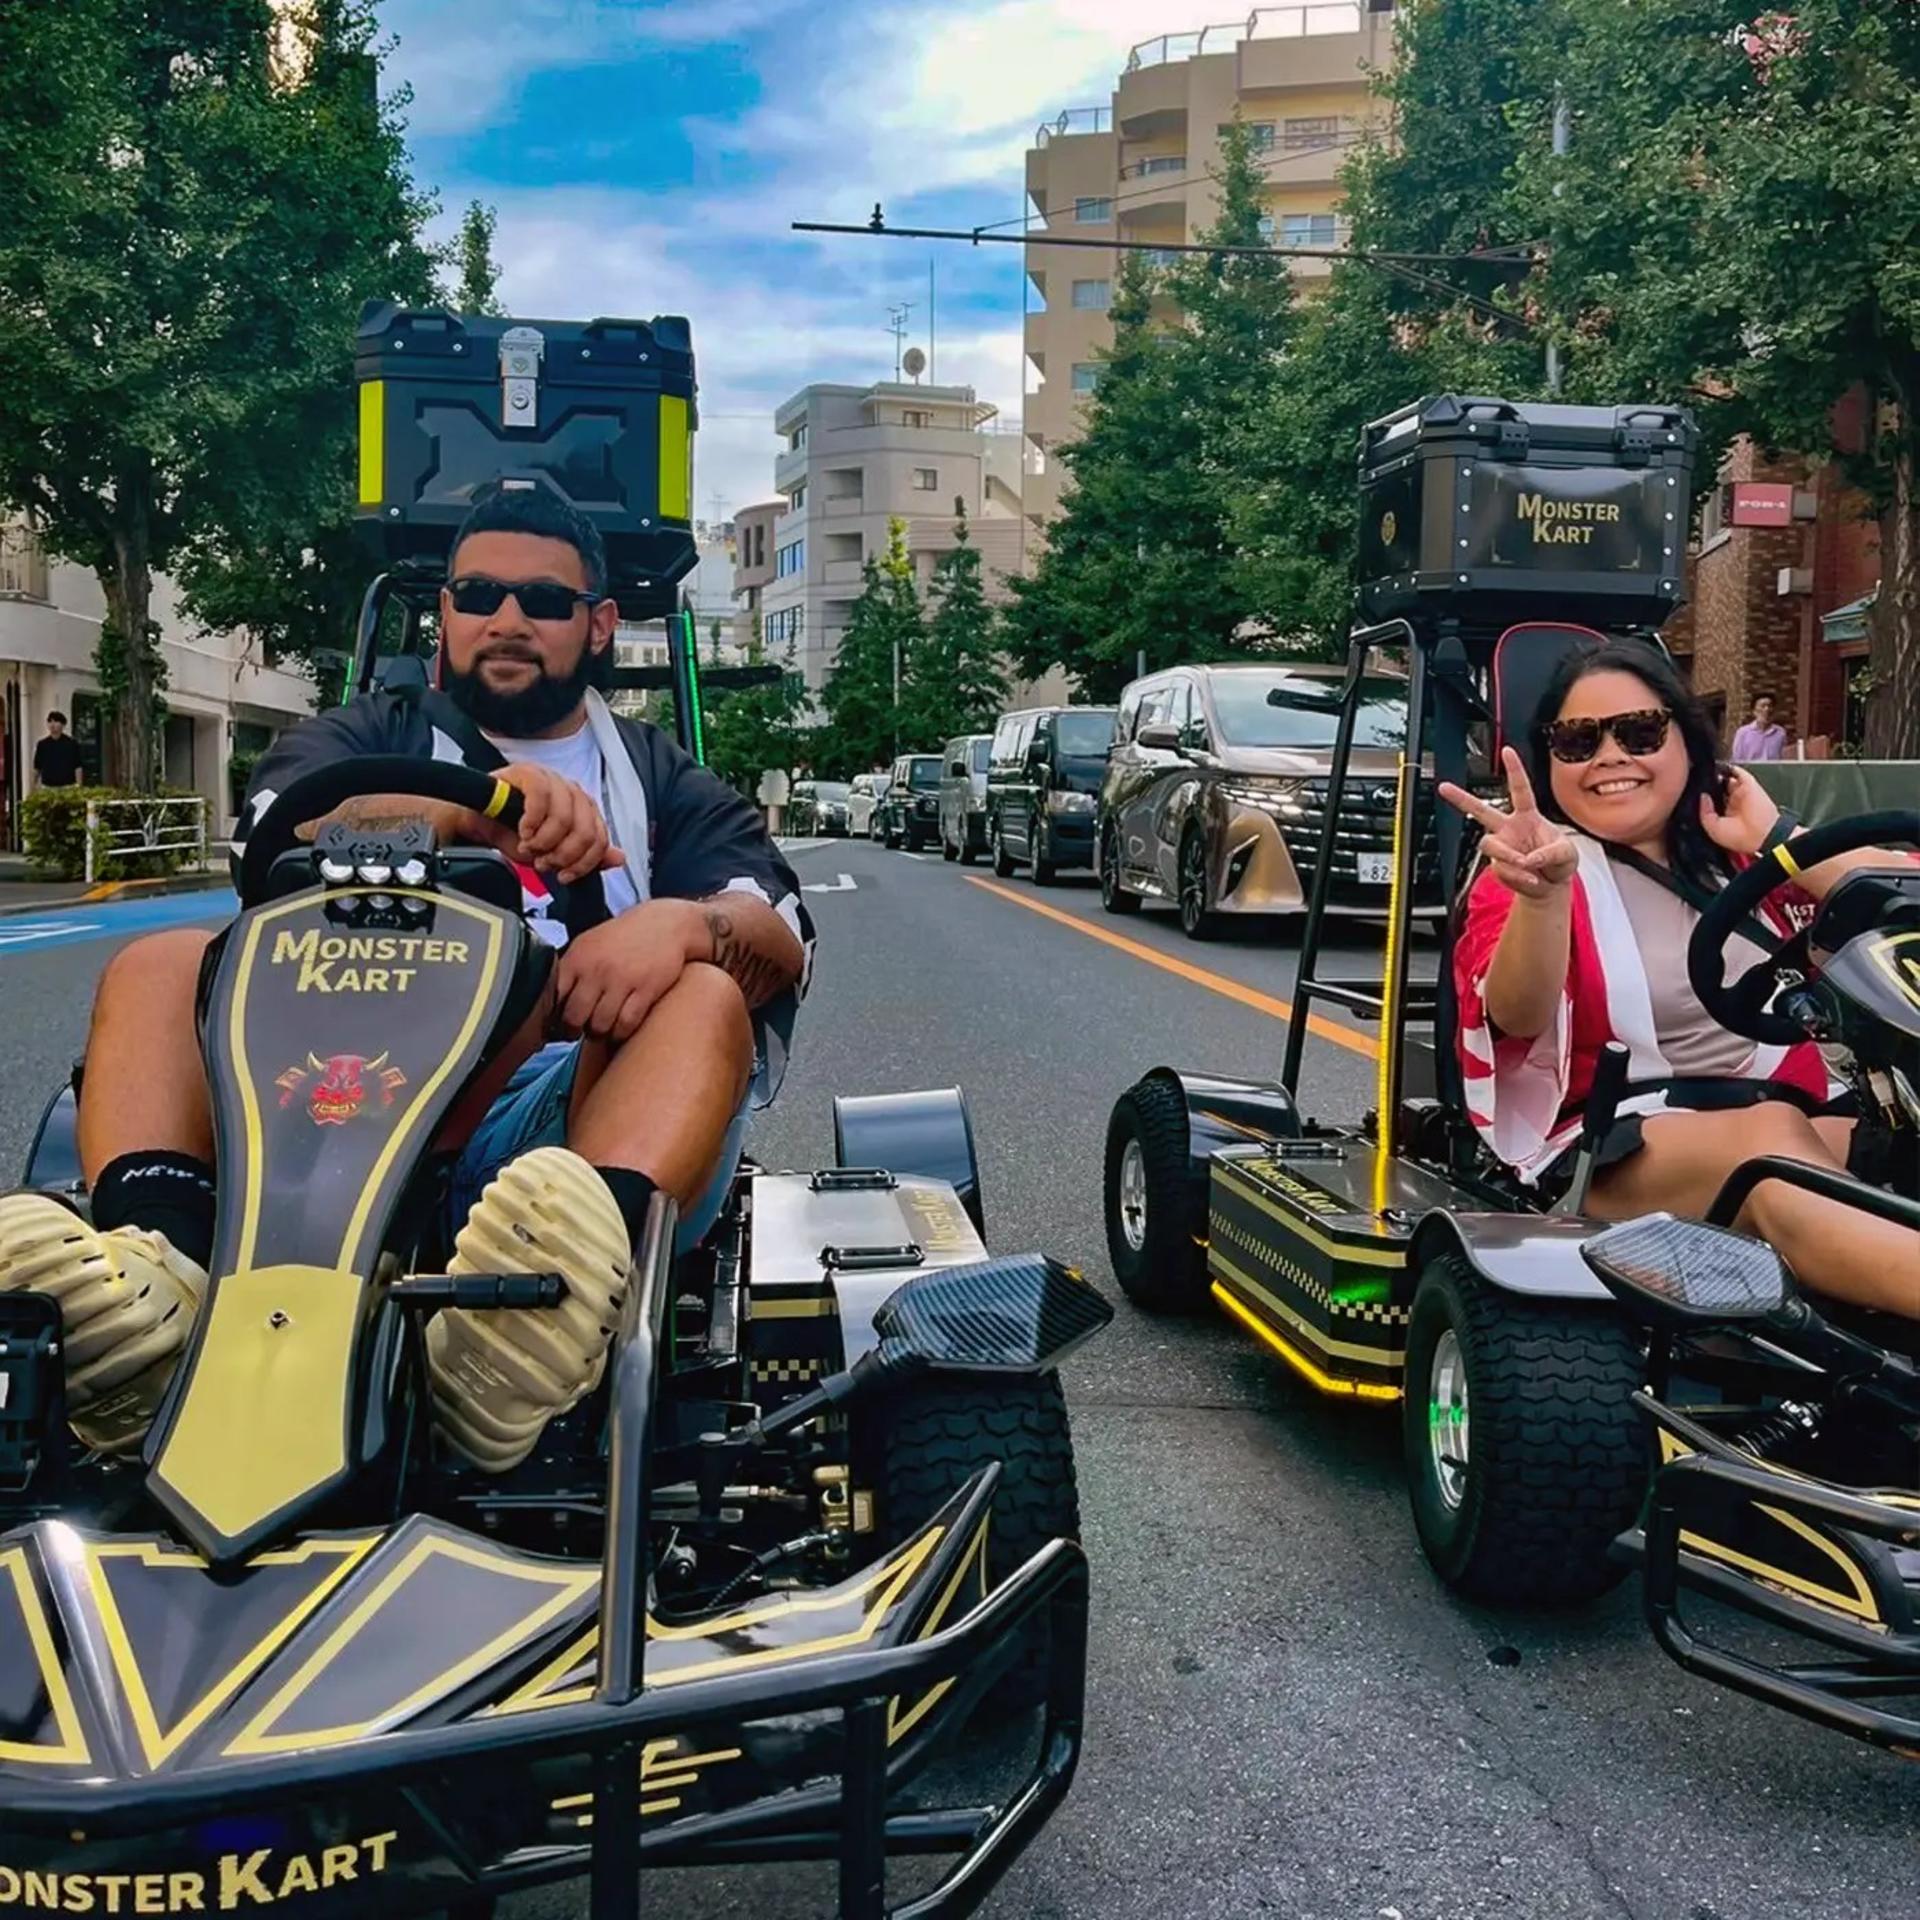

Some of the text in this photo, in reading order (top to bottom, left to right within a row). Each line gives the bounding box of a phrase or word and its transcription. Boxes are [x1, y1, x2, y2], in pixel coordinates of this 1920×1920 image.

[1517, 492, 1620, 522] MONSTER
[1533, 519, 1594, 544] KART
[271, 928, 470, 963] MONSTER
[296, 961, 417, 992] KART
[218, 1830, 397, 1910] KART
